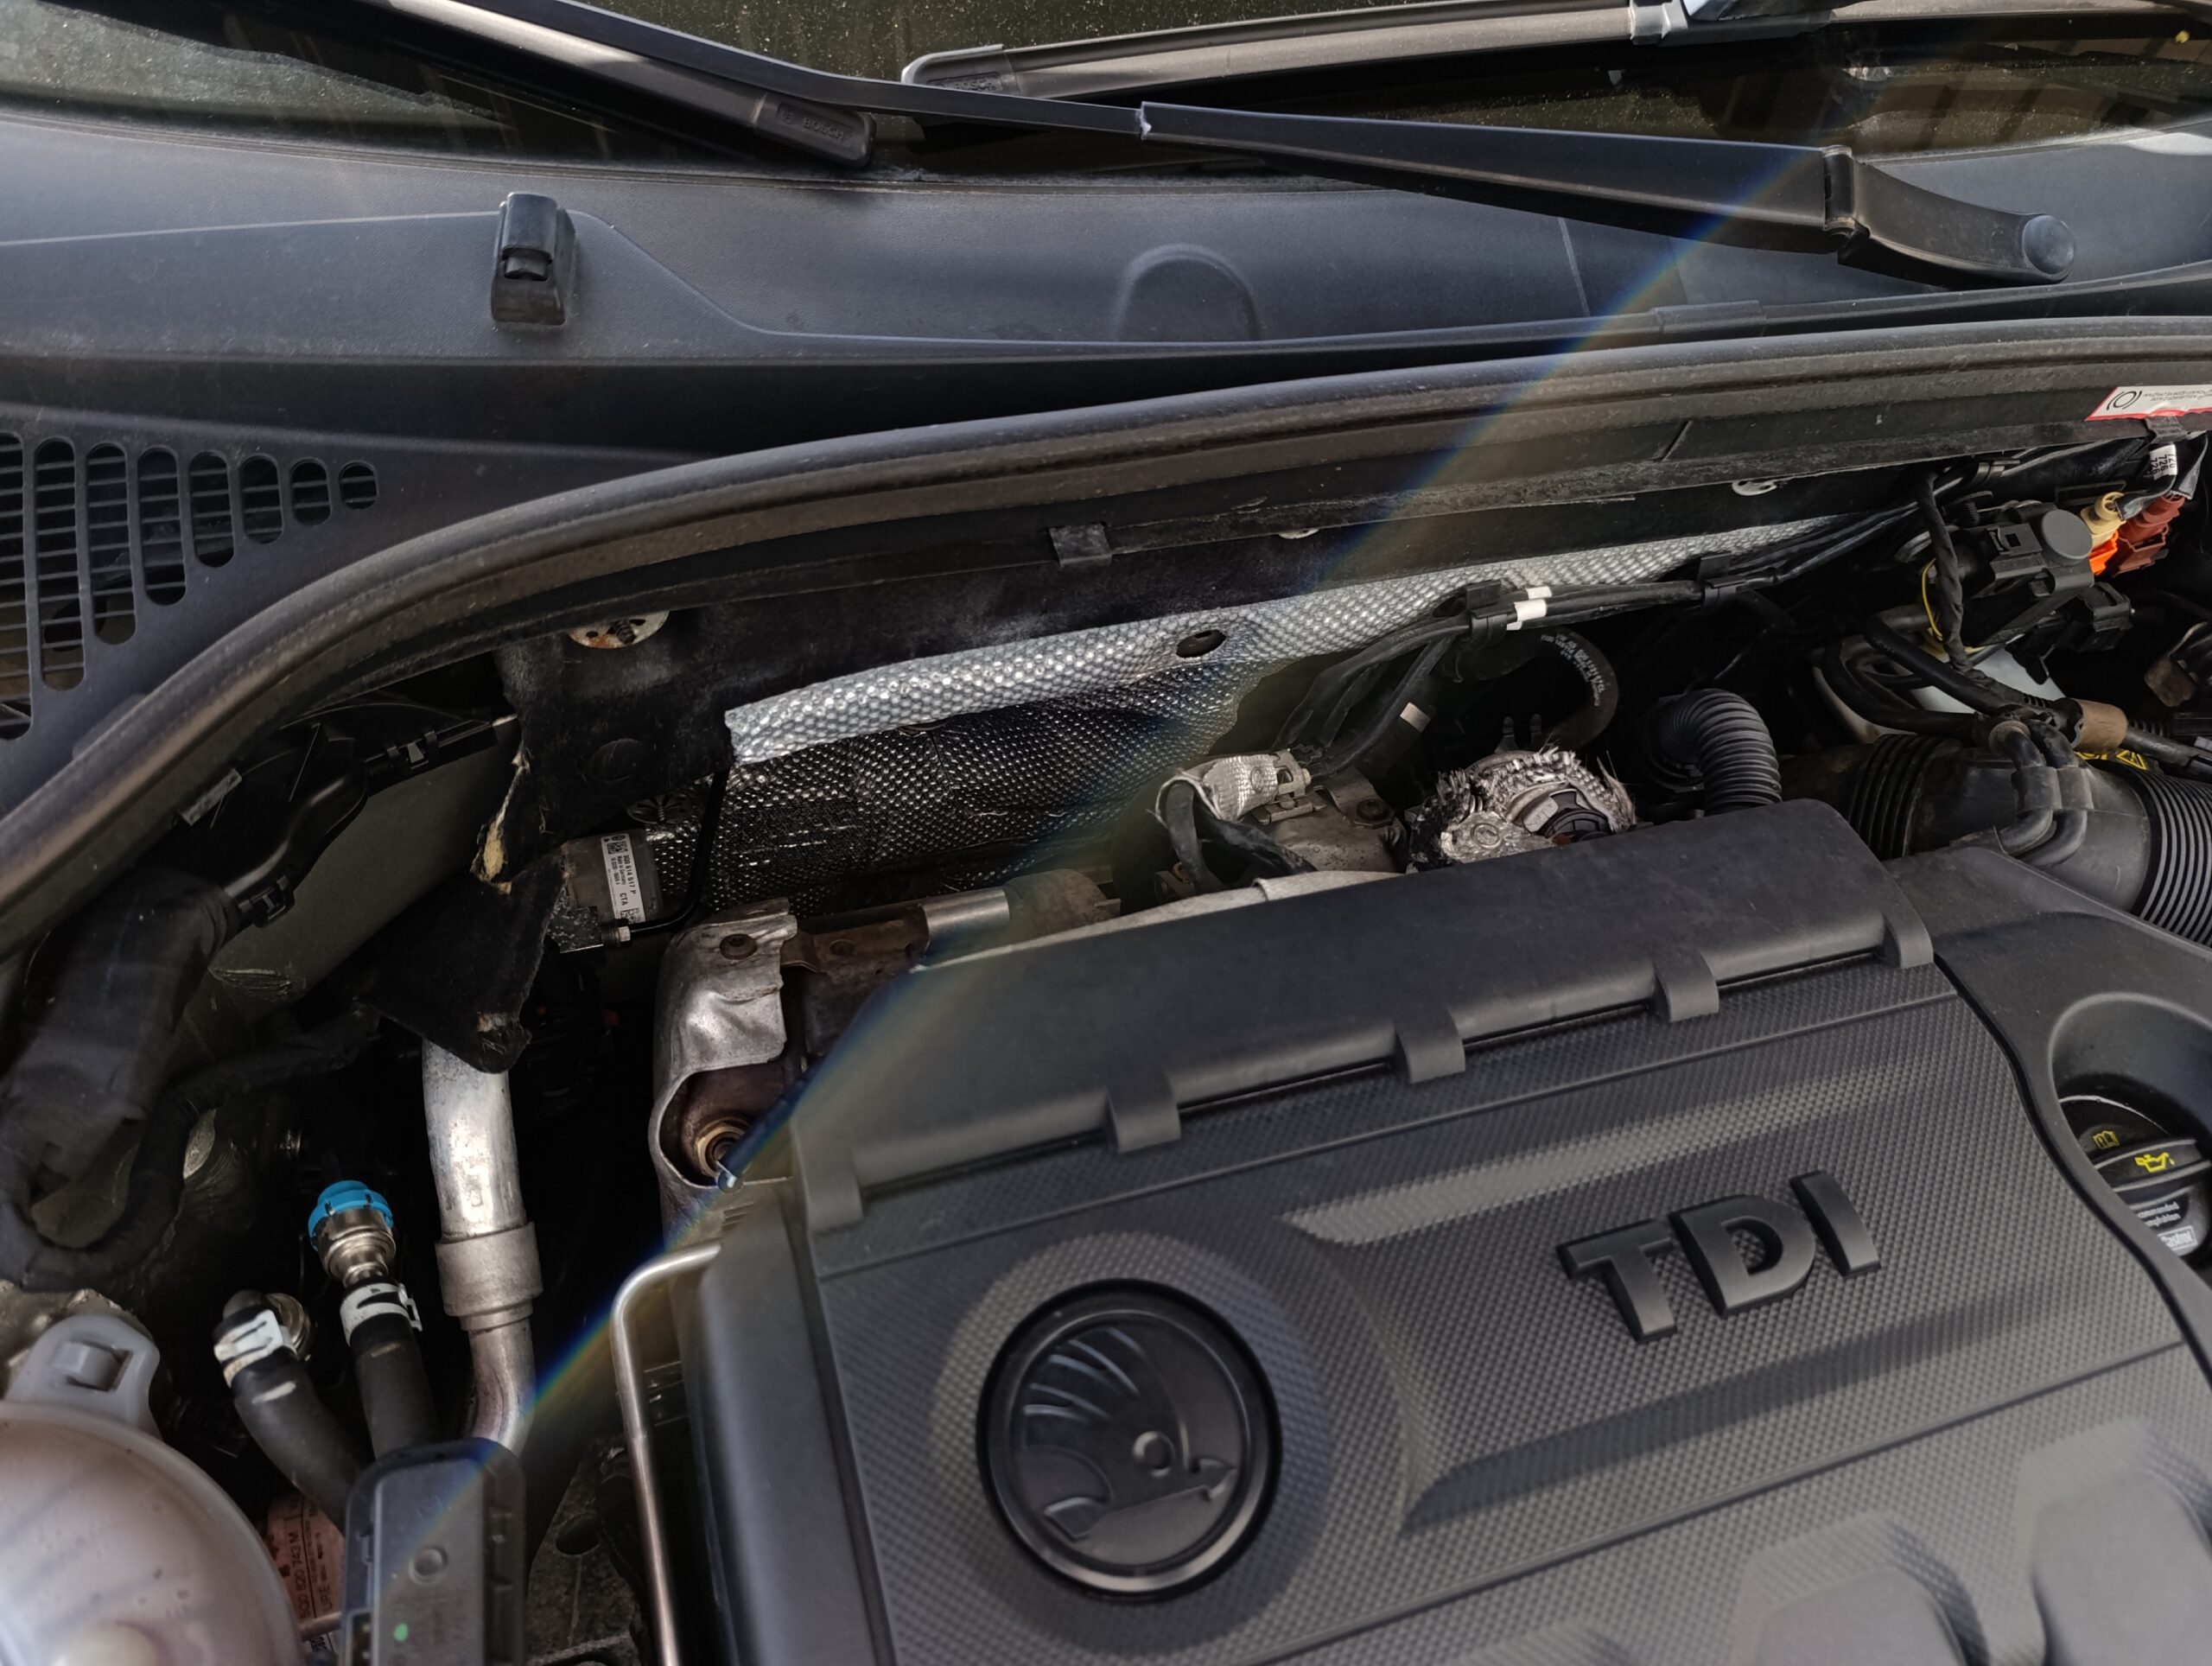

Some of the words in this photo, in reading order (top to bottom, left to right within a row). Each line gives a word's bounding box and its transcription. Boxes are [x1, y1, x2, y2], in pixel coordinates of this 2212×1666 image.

[802, 117, 844, 142] BOSCH
[2158, 455, 2169, 471] 726
[1557, 1170, 1881, 1344] TDI
[289, 1532, 300, 1544] M
[290, 1546, 302, 1567] 743
[295, 1569, 307, 1592] 820
